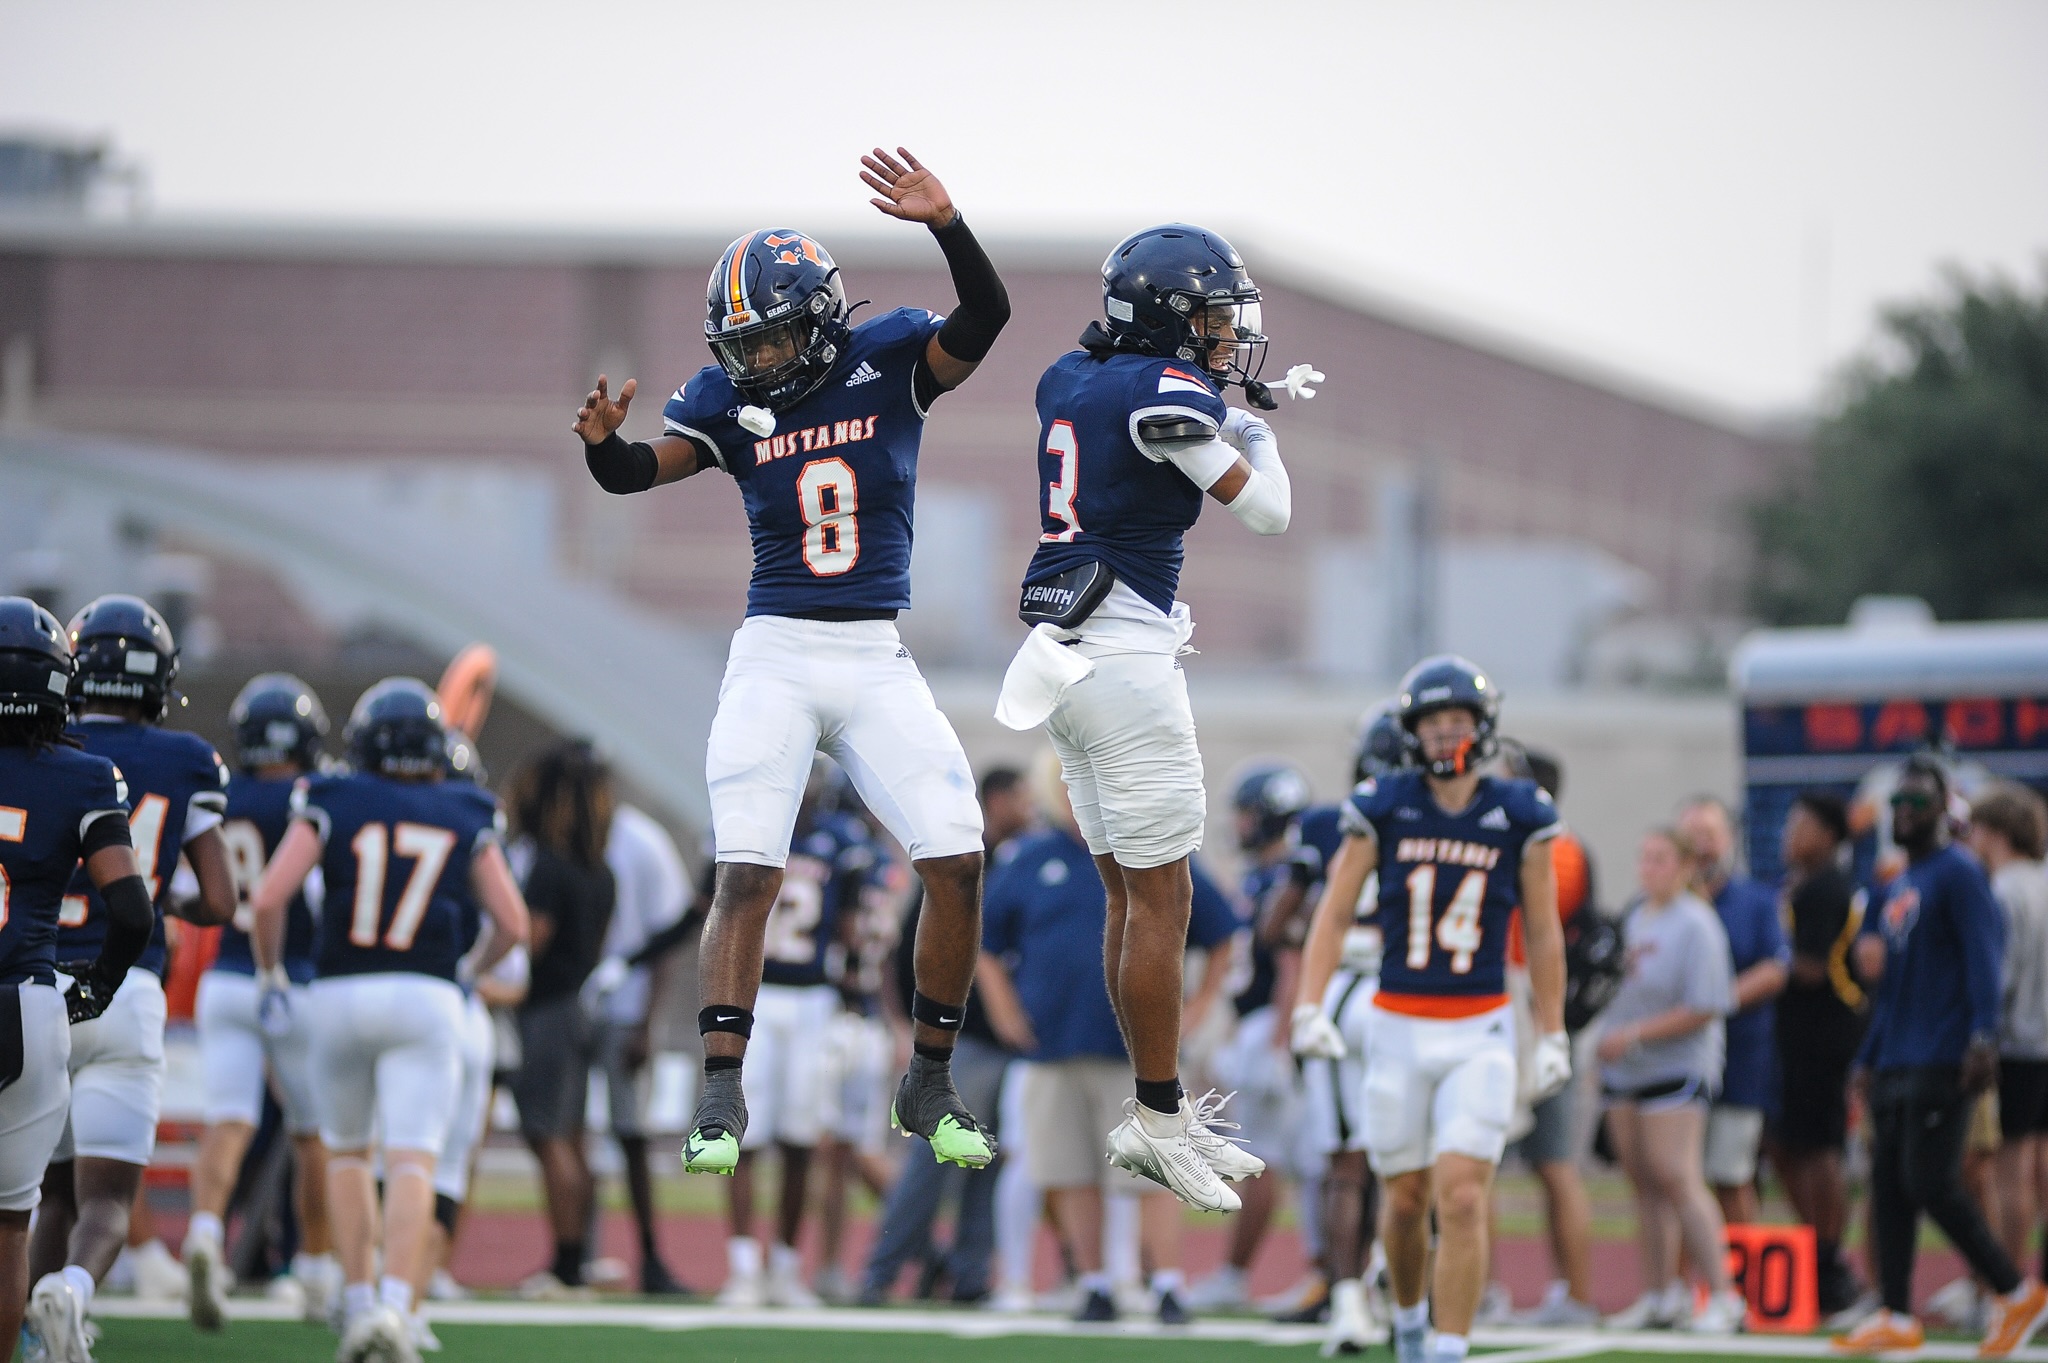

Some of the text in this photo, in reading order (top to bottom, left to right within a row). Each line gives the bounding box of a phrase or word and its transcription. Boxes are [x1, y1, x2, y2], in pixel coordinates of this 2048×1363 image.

[846, 371, 881, 387] adidas
[753, 415, 879, 467] MUSTANGS
[1040, 418, 1084, 543] 3
[796, 456, 860, 577] 8
[1023, 586, 1074, 606] XENITH
[350, 820, 457, 950] 17
[1406, 864, 1488, 974] 14
